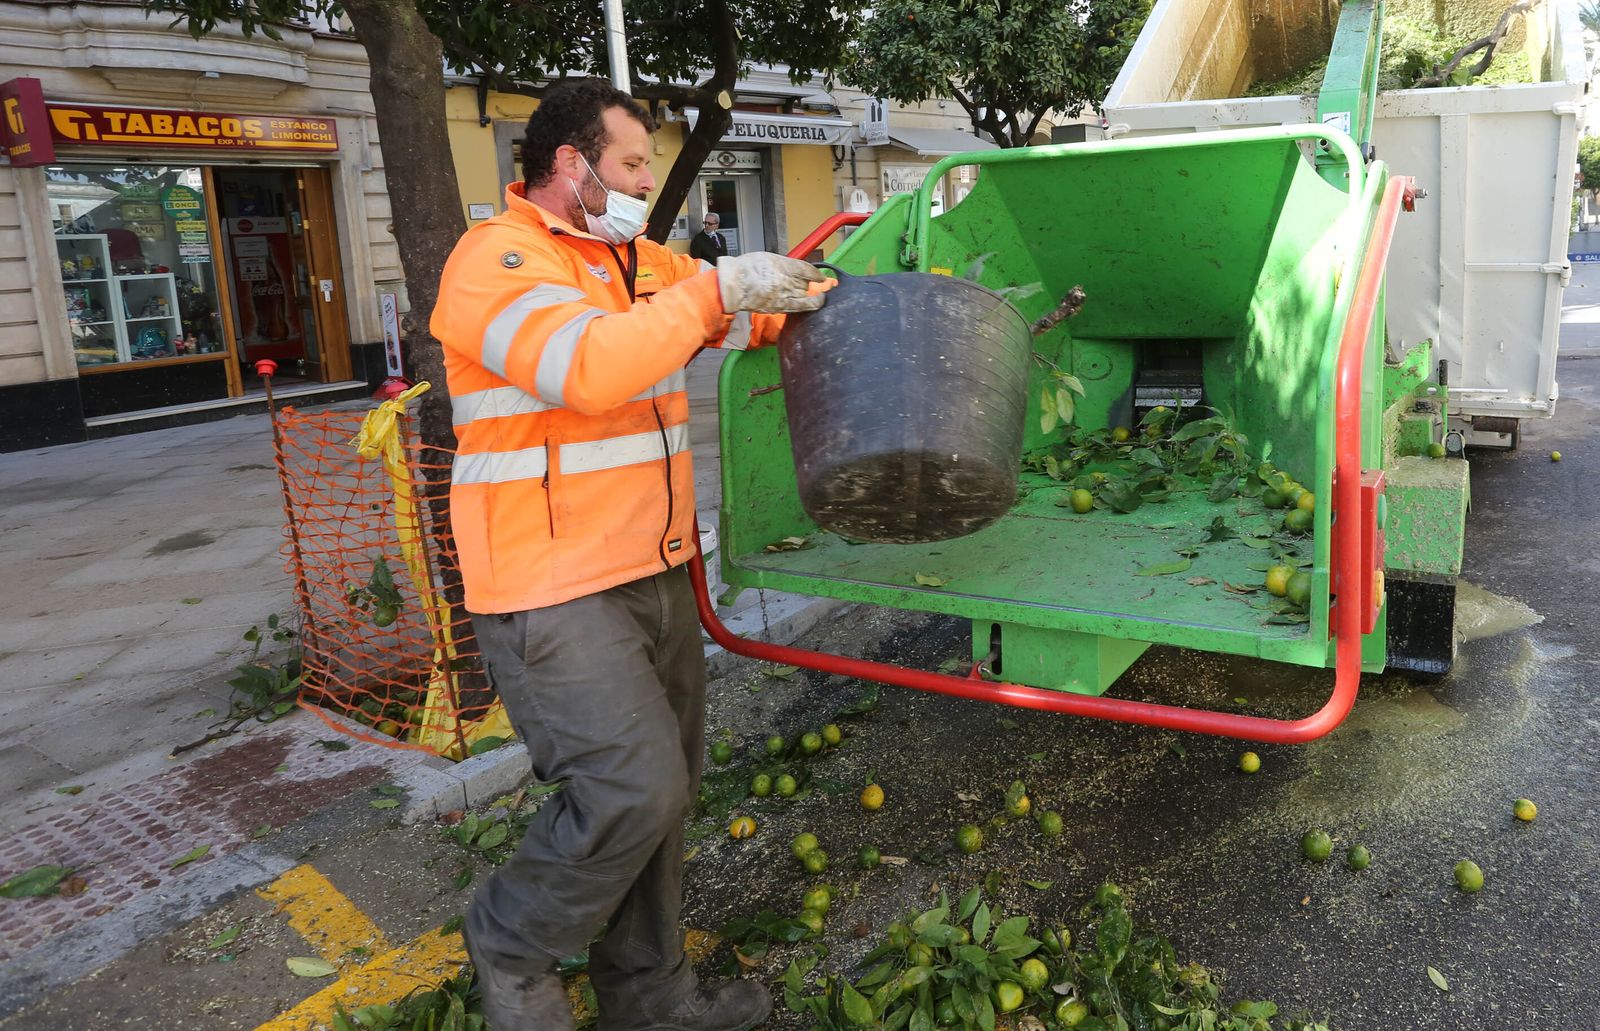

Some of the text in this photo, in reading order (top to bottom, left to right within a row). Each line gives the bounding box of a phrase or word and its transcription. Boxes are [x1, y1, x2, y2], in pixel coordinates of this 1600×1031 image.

[103, 112, 263, 138] TABACOS
[271, 121, 328, 131] ESTANCO
[271, 132, 332, 141] LIMONCHI
[722, 123, 827, 141] PELUQUERIA
[9, 143, 31, 156] TABACOS
[890, 178, 924, 192] Corred
[1585, 254, 1600, 262] SAL
